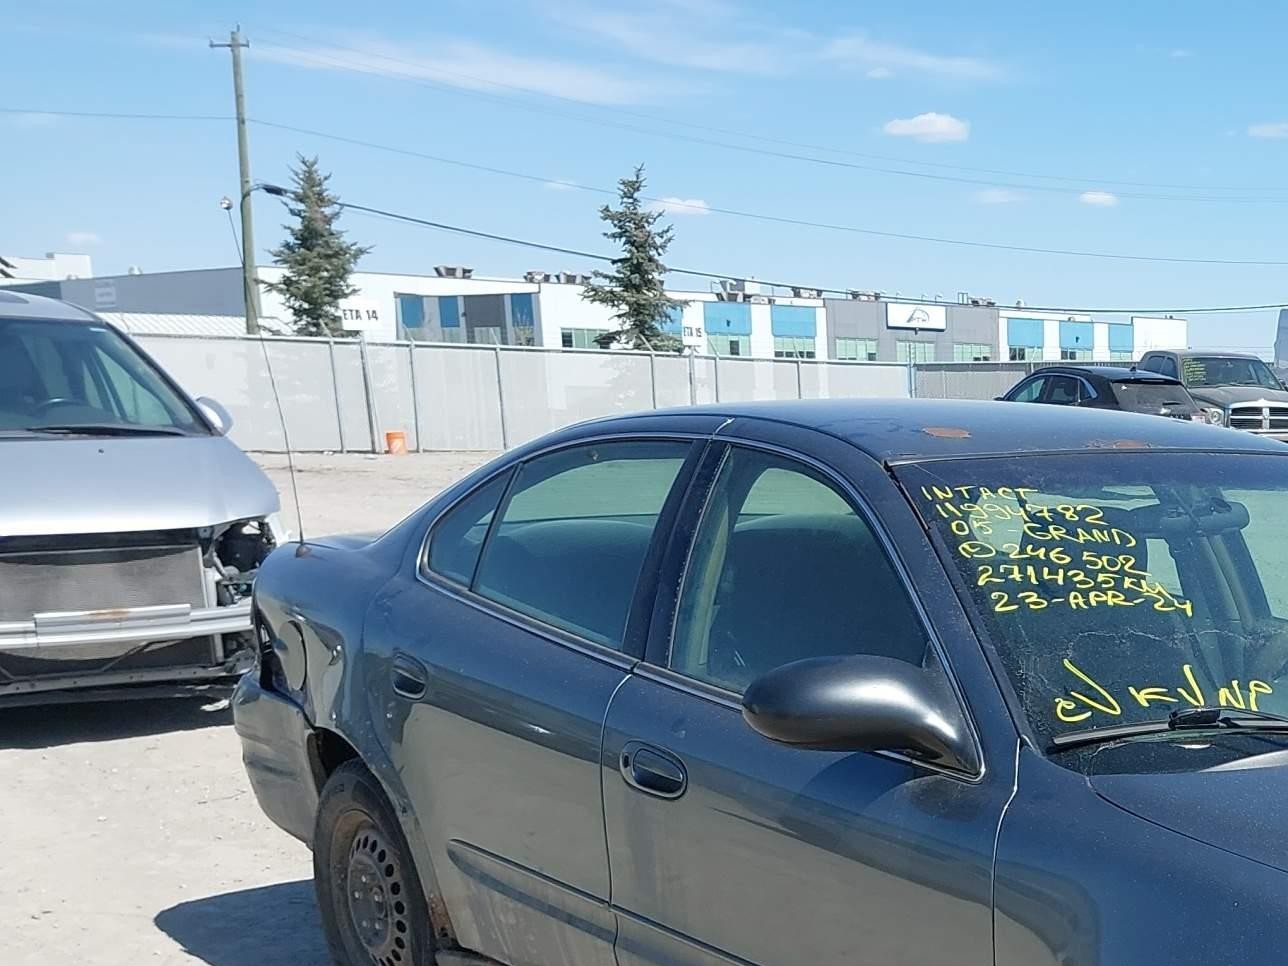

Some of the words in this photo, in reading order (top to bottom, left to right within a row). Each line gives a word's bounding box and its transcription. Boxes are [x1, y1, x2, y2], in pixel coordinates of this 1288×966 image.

[343, 309, 362, 320] ETA
[366, 309, 378, 321] 14
[920, 485, 1039, 501] INTACT
[935, 502, 1110, 526] 11994782
[1002, 543, 1072, 565] 246
[1082, 551, 1153, 577] 502
